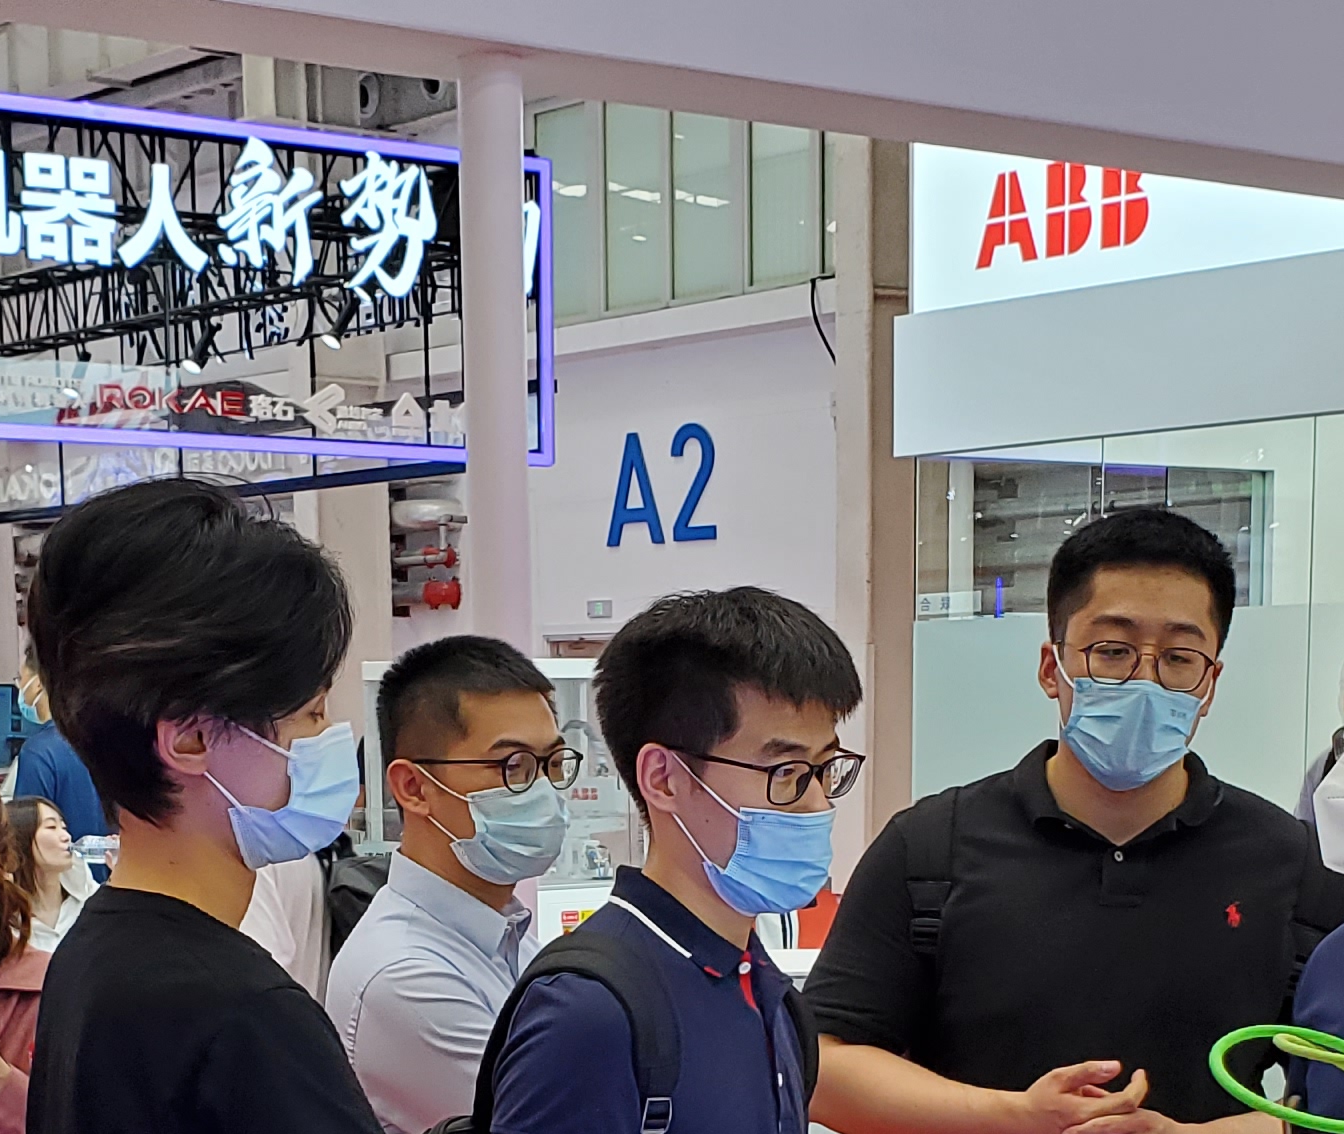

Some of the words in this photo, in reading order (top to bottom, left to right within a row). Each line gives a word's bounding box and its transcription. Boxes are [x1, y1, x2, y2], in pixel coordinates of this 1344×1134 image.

[975, 159, 1151, 270] ABB
[97, 383, 246, 419] ROKAE
[606, 422, 718, 548] A2
[570, 788, 599, 801] ABB
